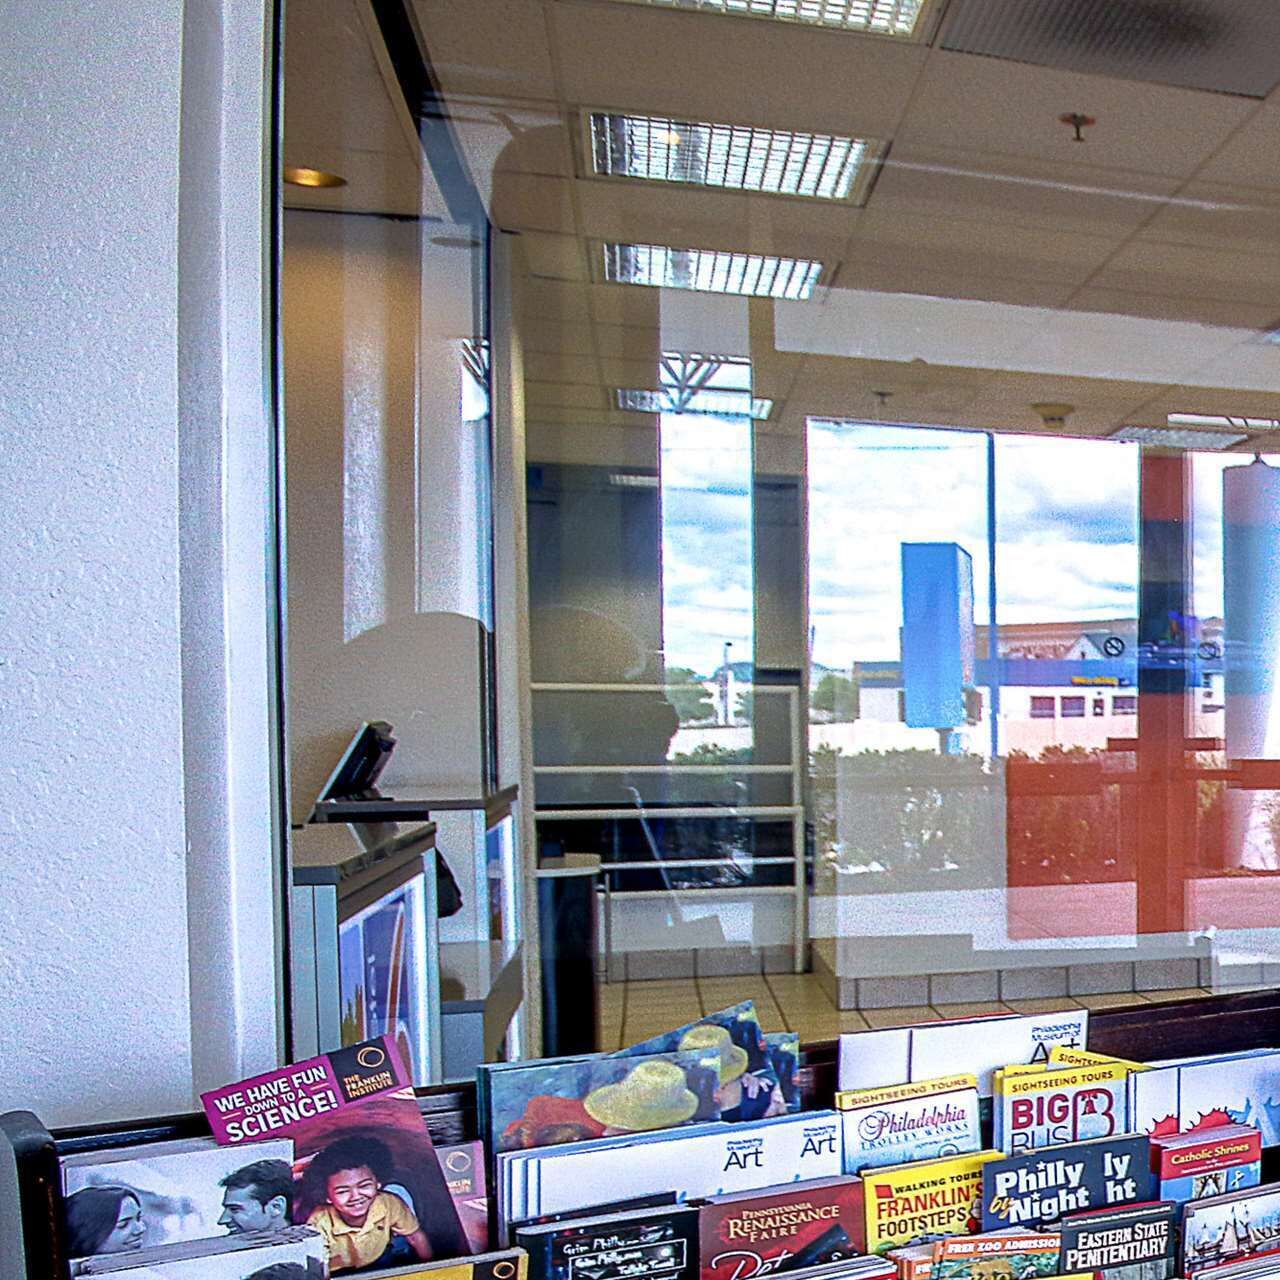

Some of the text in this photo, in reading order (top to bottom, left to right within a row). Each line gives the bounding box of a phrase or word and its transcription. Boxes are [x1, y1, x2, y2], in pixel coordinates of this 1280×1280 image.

[214, 1066, 328, 1113] WE HAVE FUN
[1012, 1070, 1114, 1092] SIGHTSEEING TOURS
[226, 1090, 338, 1142] SCIENCE!
[858, 1105, 967, 1142] Philadelphia
[1012, 1096, 1069, 1130] BIG
[723, 1148, 763, 1171] Art
[1171, 1141, 1249, 1165] Catholic Shrines
[995, 1161, 1084, 1198] Philly
[728, 1204, 840, 1239] RENAISSANCE
[750, 1226, 798, 1243] FAIRE
[877, 1207, 967, 1238] FOOTSTEPS
[1078, 1220, 1168, 1250] EASTERN STATE
[1066, 1236, 1168, 1271] PENITENTIARY
